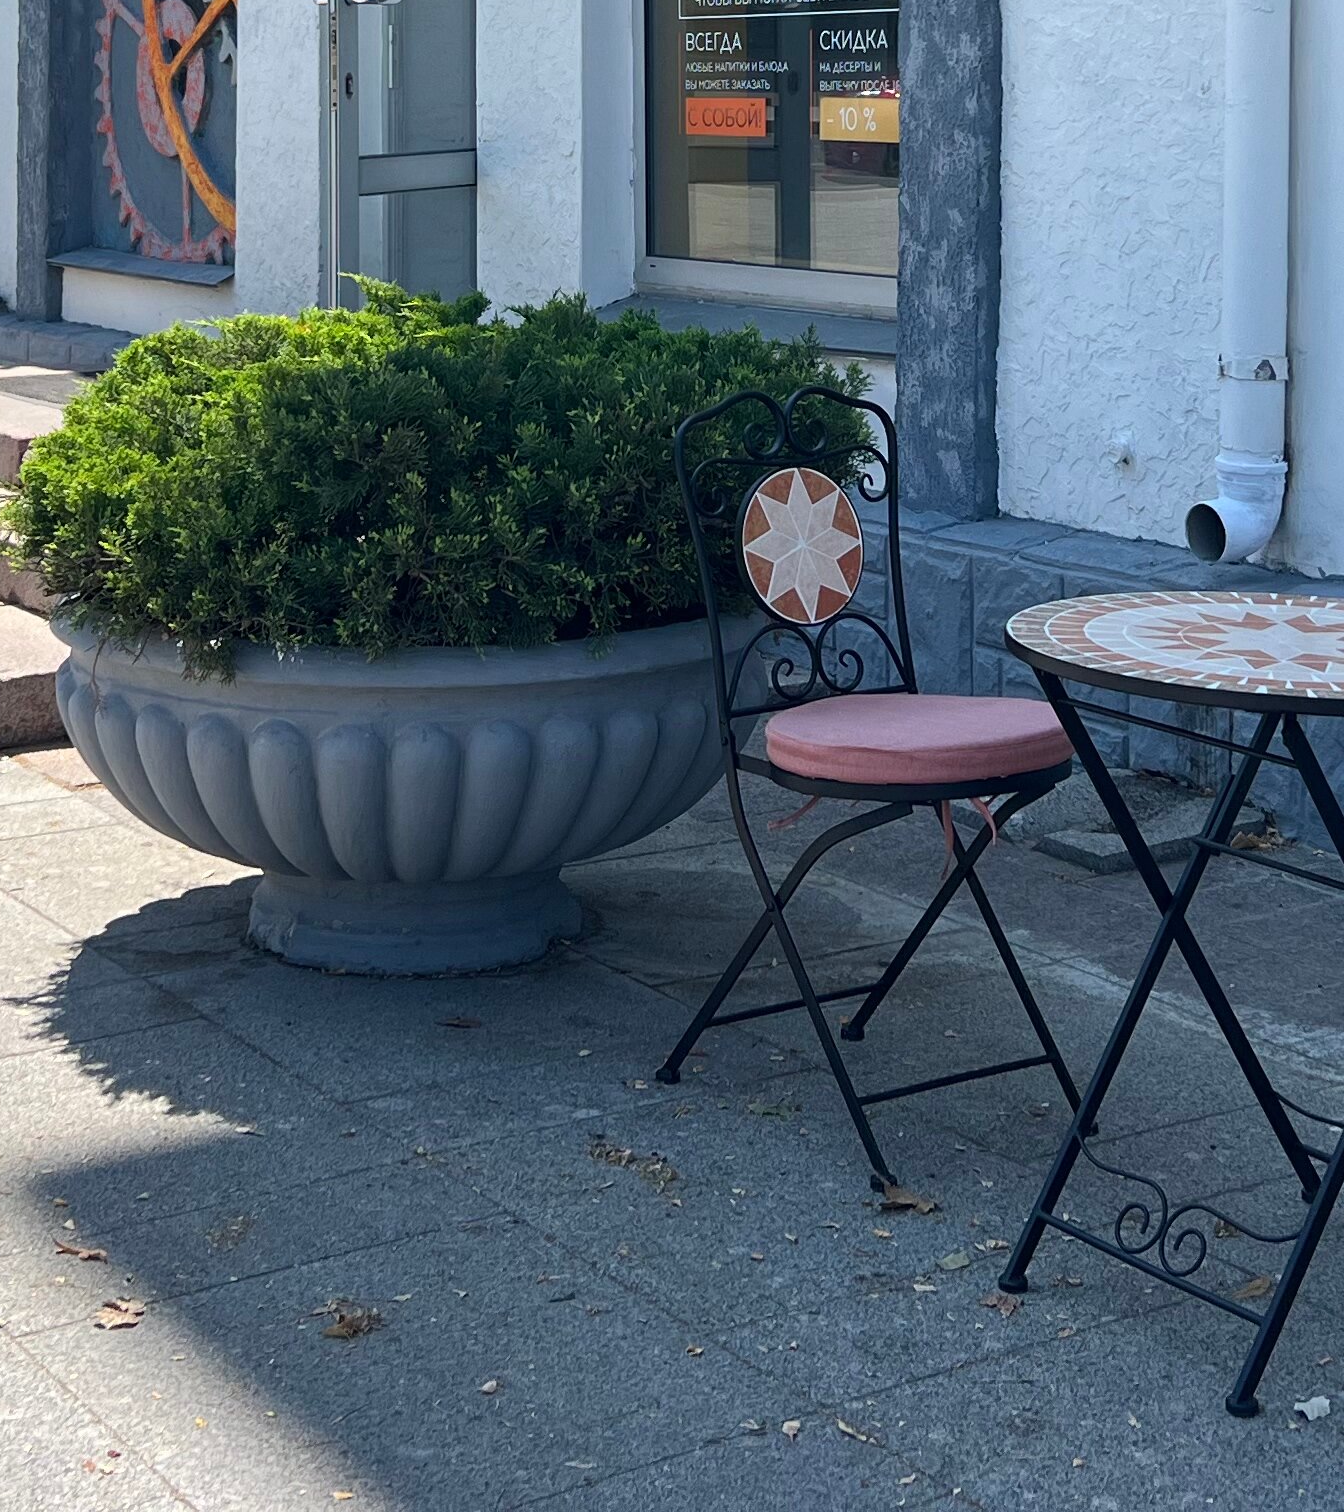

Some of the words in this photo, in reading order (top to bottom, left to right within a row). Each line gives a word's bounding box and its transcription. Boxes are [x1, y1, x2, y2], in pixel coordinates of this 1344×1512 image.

[685, 31, 742, 55] ВСЕГДА
[819, 29, 888, 53] СКИДКА
[685, 61, 713, 73] ЛЮБЫЕ
[715, 61, 750, 72] НАПИТКИ
[751, 61, 757, 72] И
[759, 60, 789, 73] БЛЮДА
[819, 61, 831, 72] НА
[832, 61, 872, 74] ДЕСЕРТЫ
[874, 61, 881, 72] И
[685, 79, 697, 90] ВЫ
[698, 79, 729, 90] МОЖЕТЕ
[731, 79, 771, 90] ЗАКАЗАТЬ
[861, 80, 890, 91] ПОСЛЕ
[702, 103, 762, 128] СОБОЙ!
